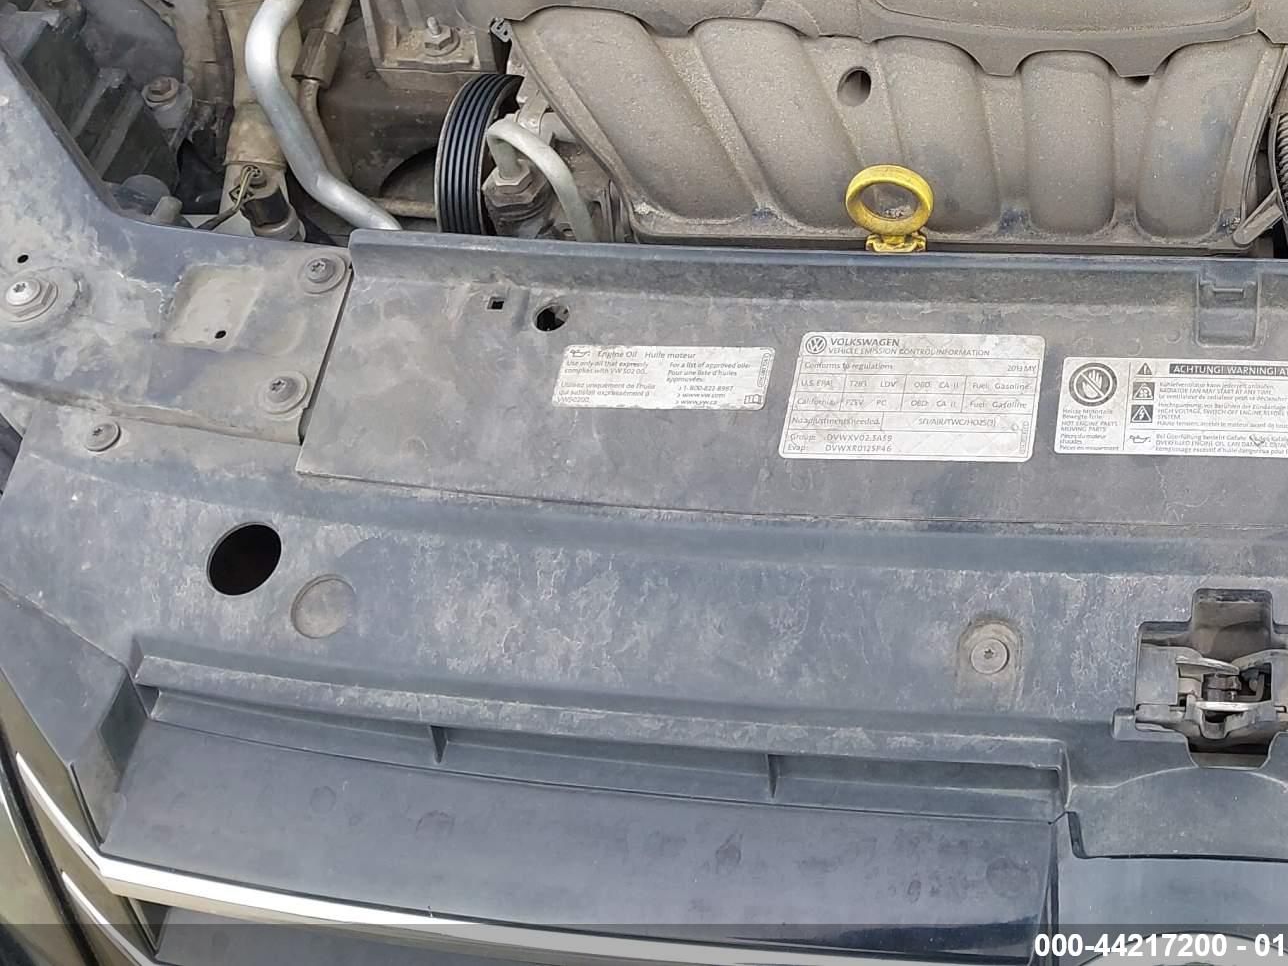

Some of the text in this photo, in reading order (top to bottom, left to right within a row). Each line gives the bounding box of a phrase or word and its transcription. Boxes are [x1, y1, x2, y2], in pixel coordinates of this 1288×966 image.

[831, 338, 900, 347] VOLKSWAGEN
[598, 350, 624, 360] Engine
[899, 348, 934, 356] CONTROL
[805, 361, 840, 370] Conforms
[1174, 365, 1224, 374] ACHTUNG!
[1227, 366, 1276, 376] WARNING!
